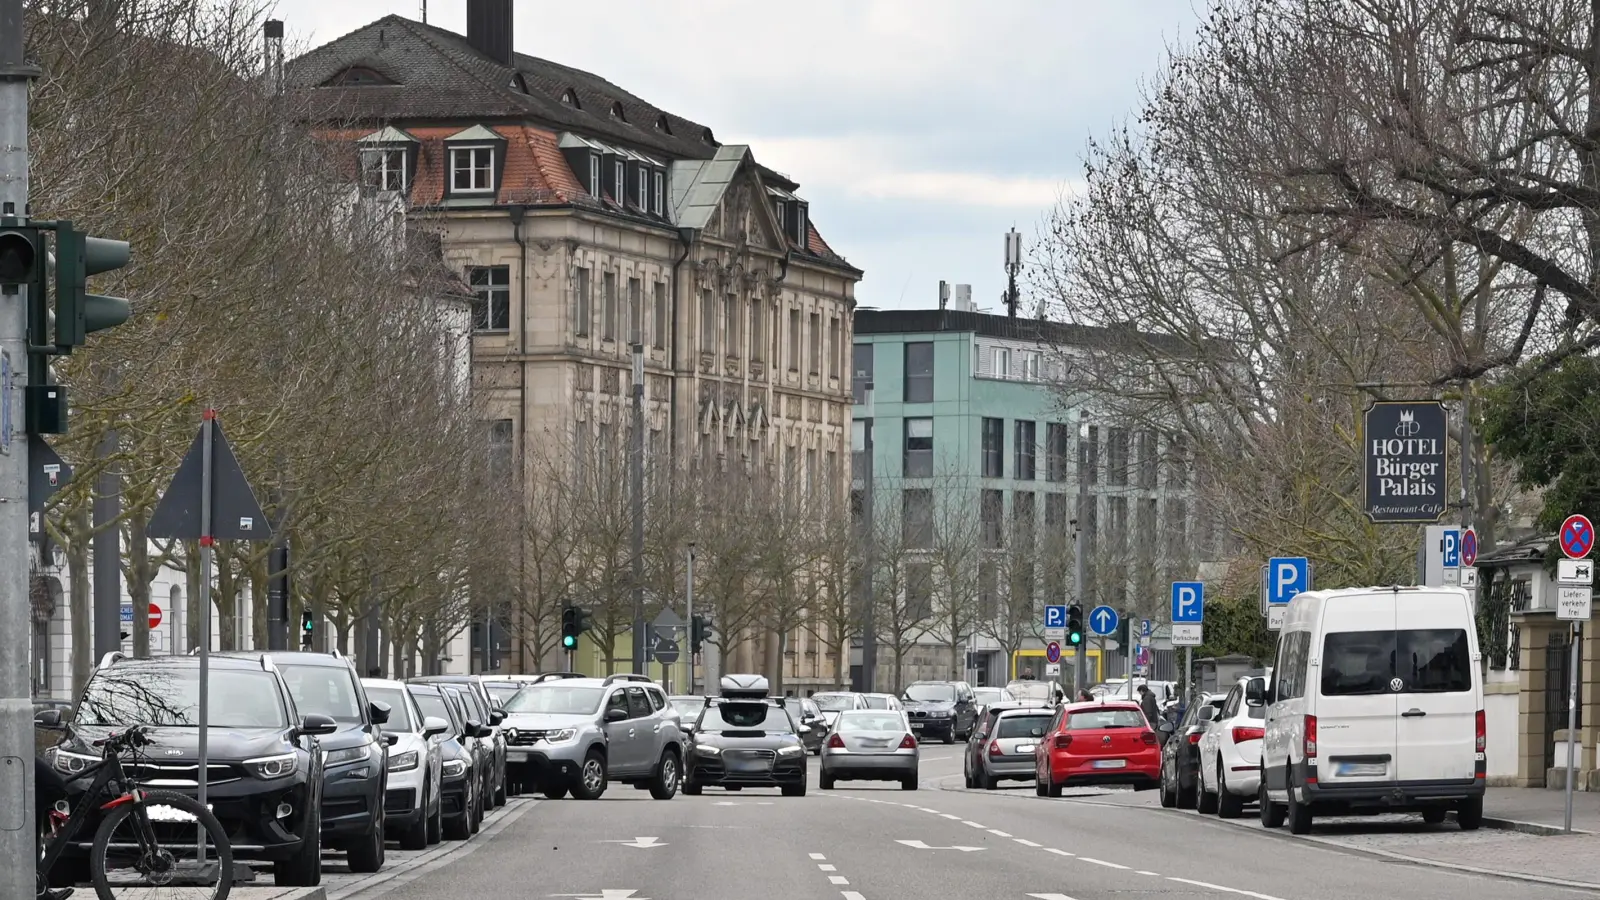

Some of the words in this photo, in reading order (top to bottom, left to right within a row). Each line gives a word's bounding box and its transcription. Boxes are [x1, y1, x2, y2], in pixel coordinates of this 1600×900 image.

[1373, 439, 1443, 455] HOTEL
[1376, 458, 1439, 479] Bürger
[1380, 478, 1436, 496] Palais
[1445, 535, 1455, 563] P
[1277, 563, 1298, 598] P
[1179, 587, 1196, 617] P
[1563, 590, 1585, 598] Liefer-
[1048, 608, 1060, 625] P
[1568, 608, 1580, 616] frei
